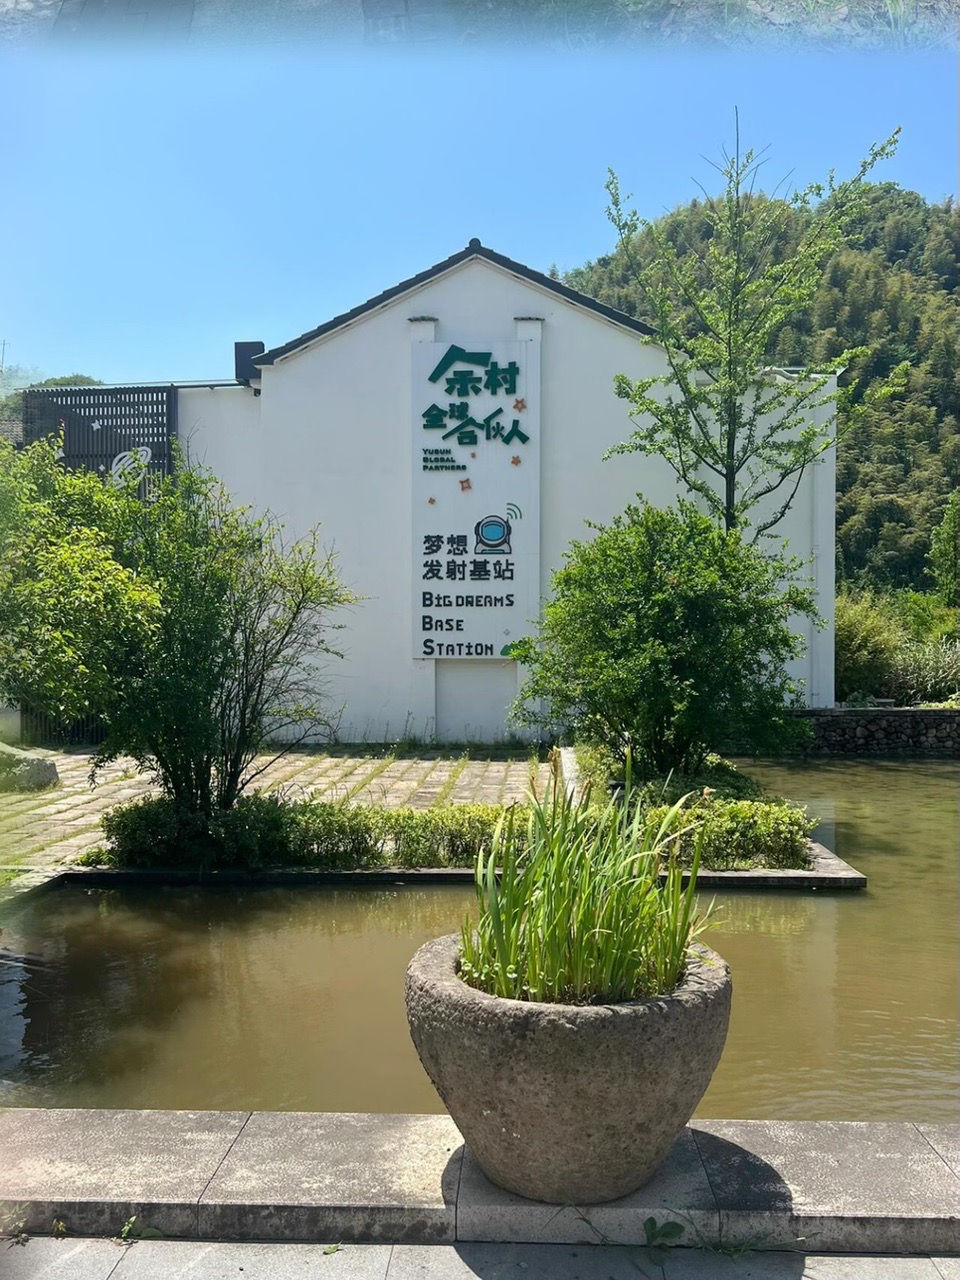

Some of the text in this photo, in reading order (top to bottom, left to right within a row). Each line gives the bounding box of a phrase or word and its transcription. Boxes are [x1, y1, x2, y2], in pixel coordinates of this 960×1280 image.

[428, 344, 520, 397] 余村
[422, 402, 530, 445] 全球合伙人
[423, 534, 469, 556] 梦想
[422, 559, 515, 581] 发射基站
[455, 594, 515, 607] DREAMS
[422, 615, 464, 631] BASE
